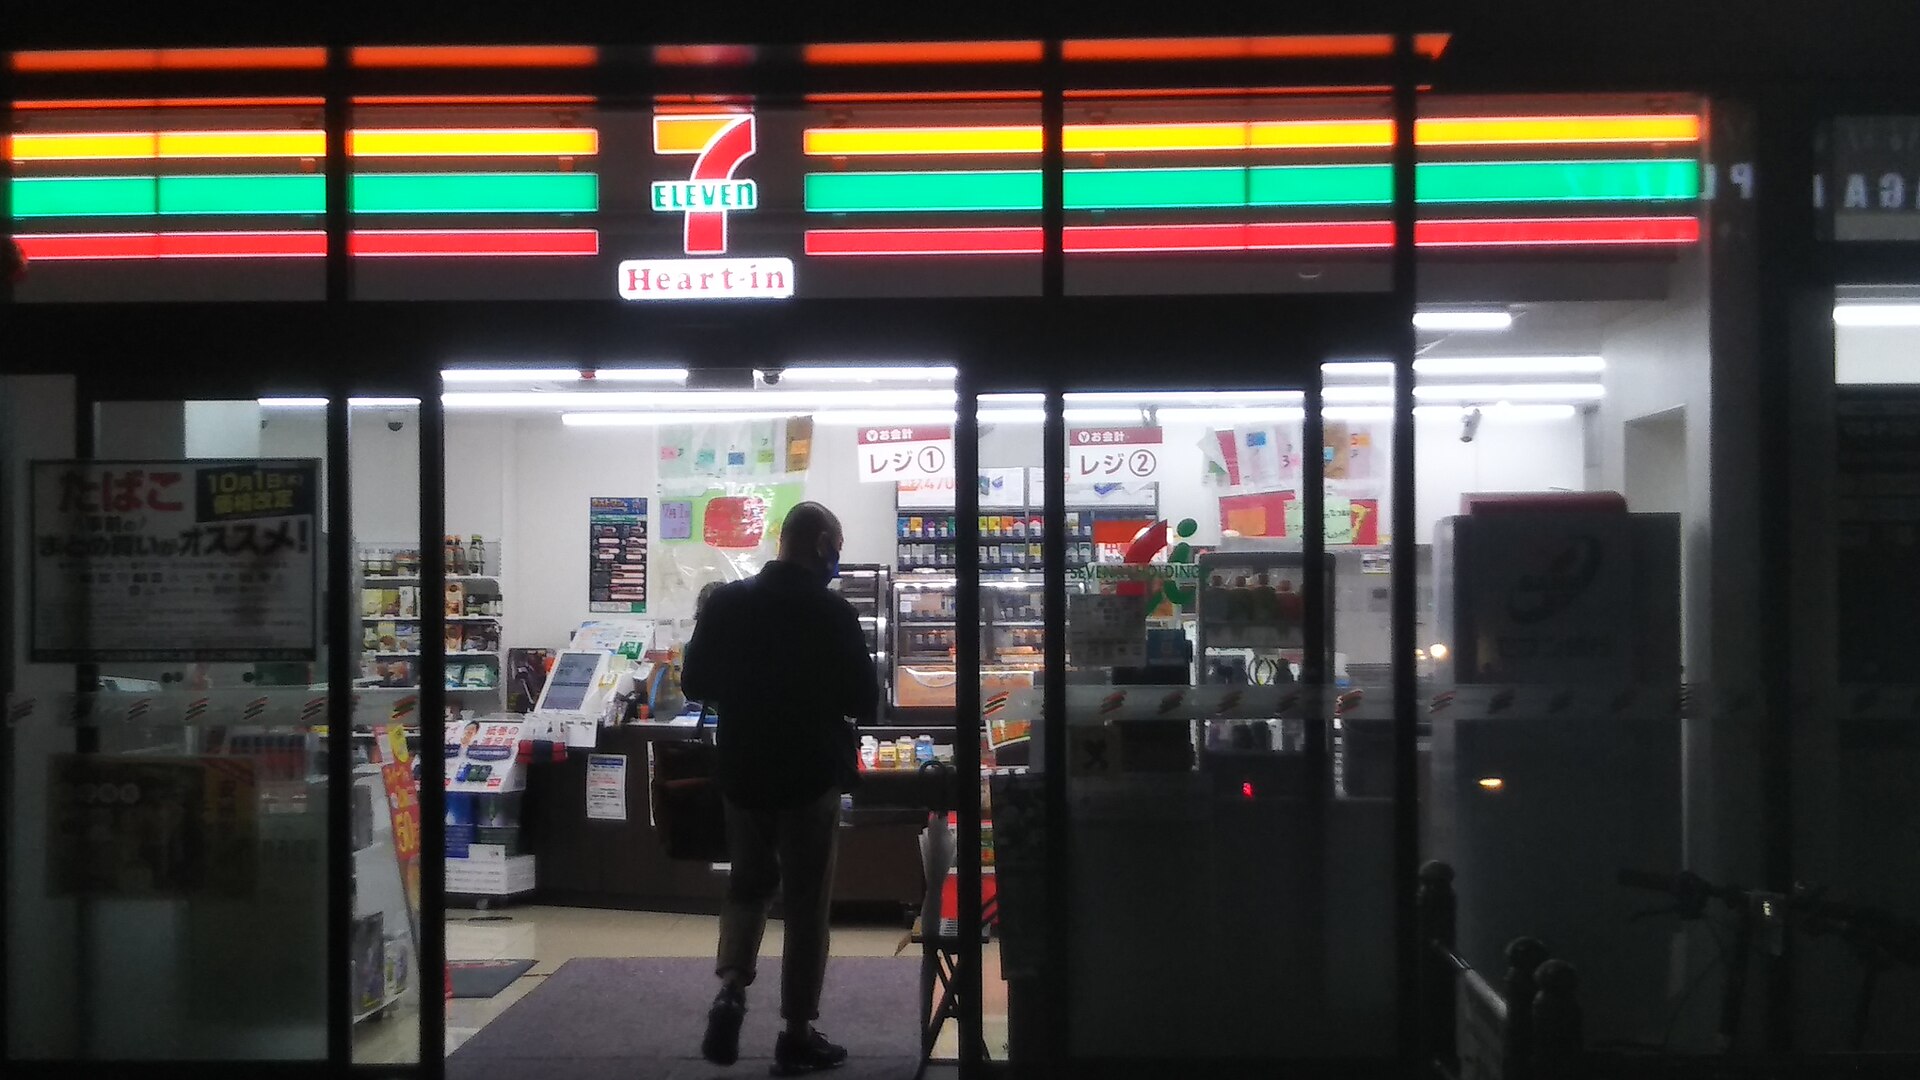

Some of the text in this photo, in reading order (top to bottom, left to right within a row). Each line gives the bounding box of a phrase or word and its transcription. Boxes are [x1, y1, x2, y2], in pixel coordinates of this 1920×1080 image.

[627, 265, 784, 290] Heart-in
[59, 470, 184, 513] たばこ
